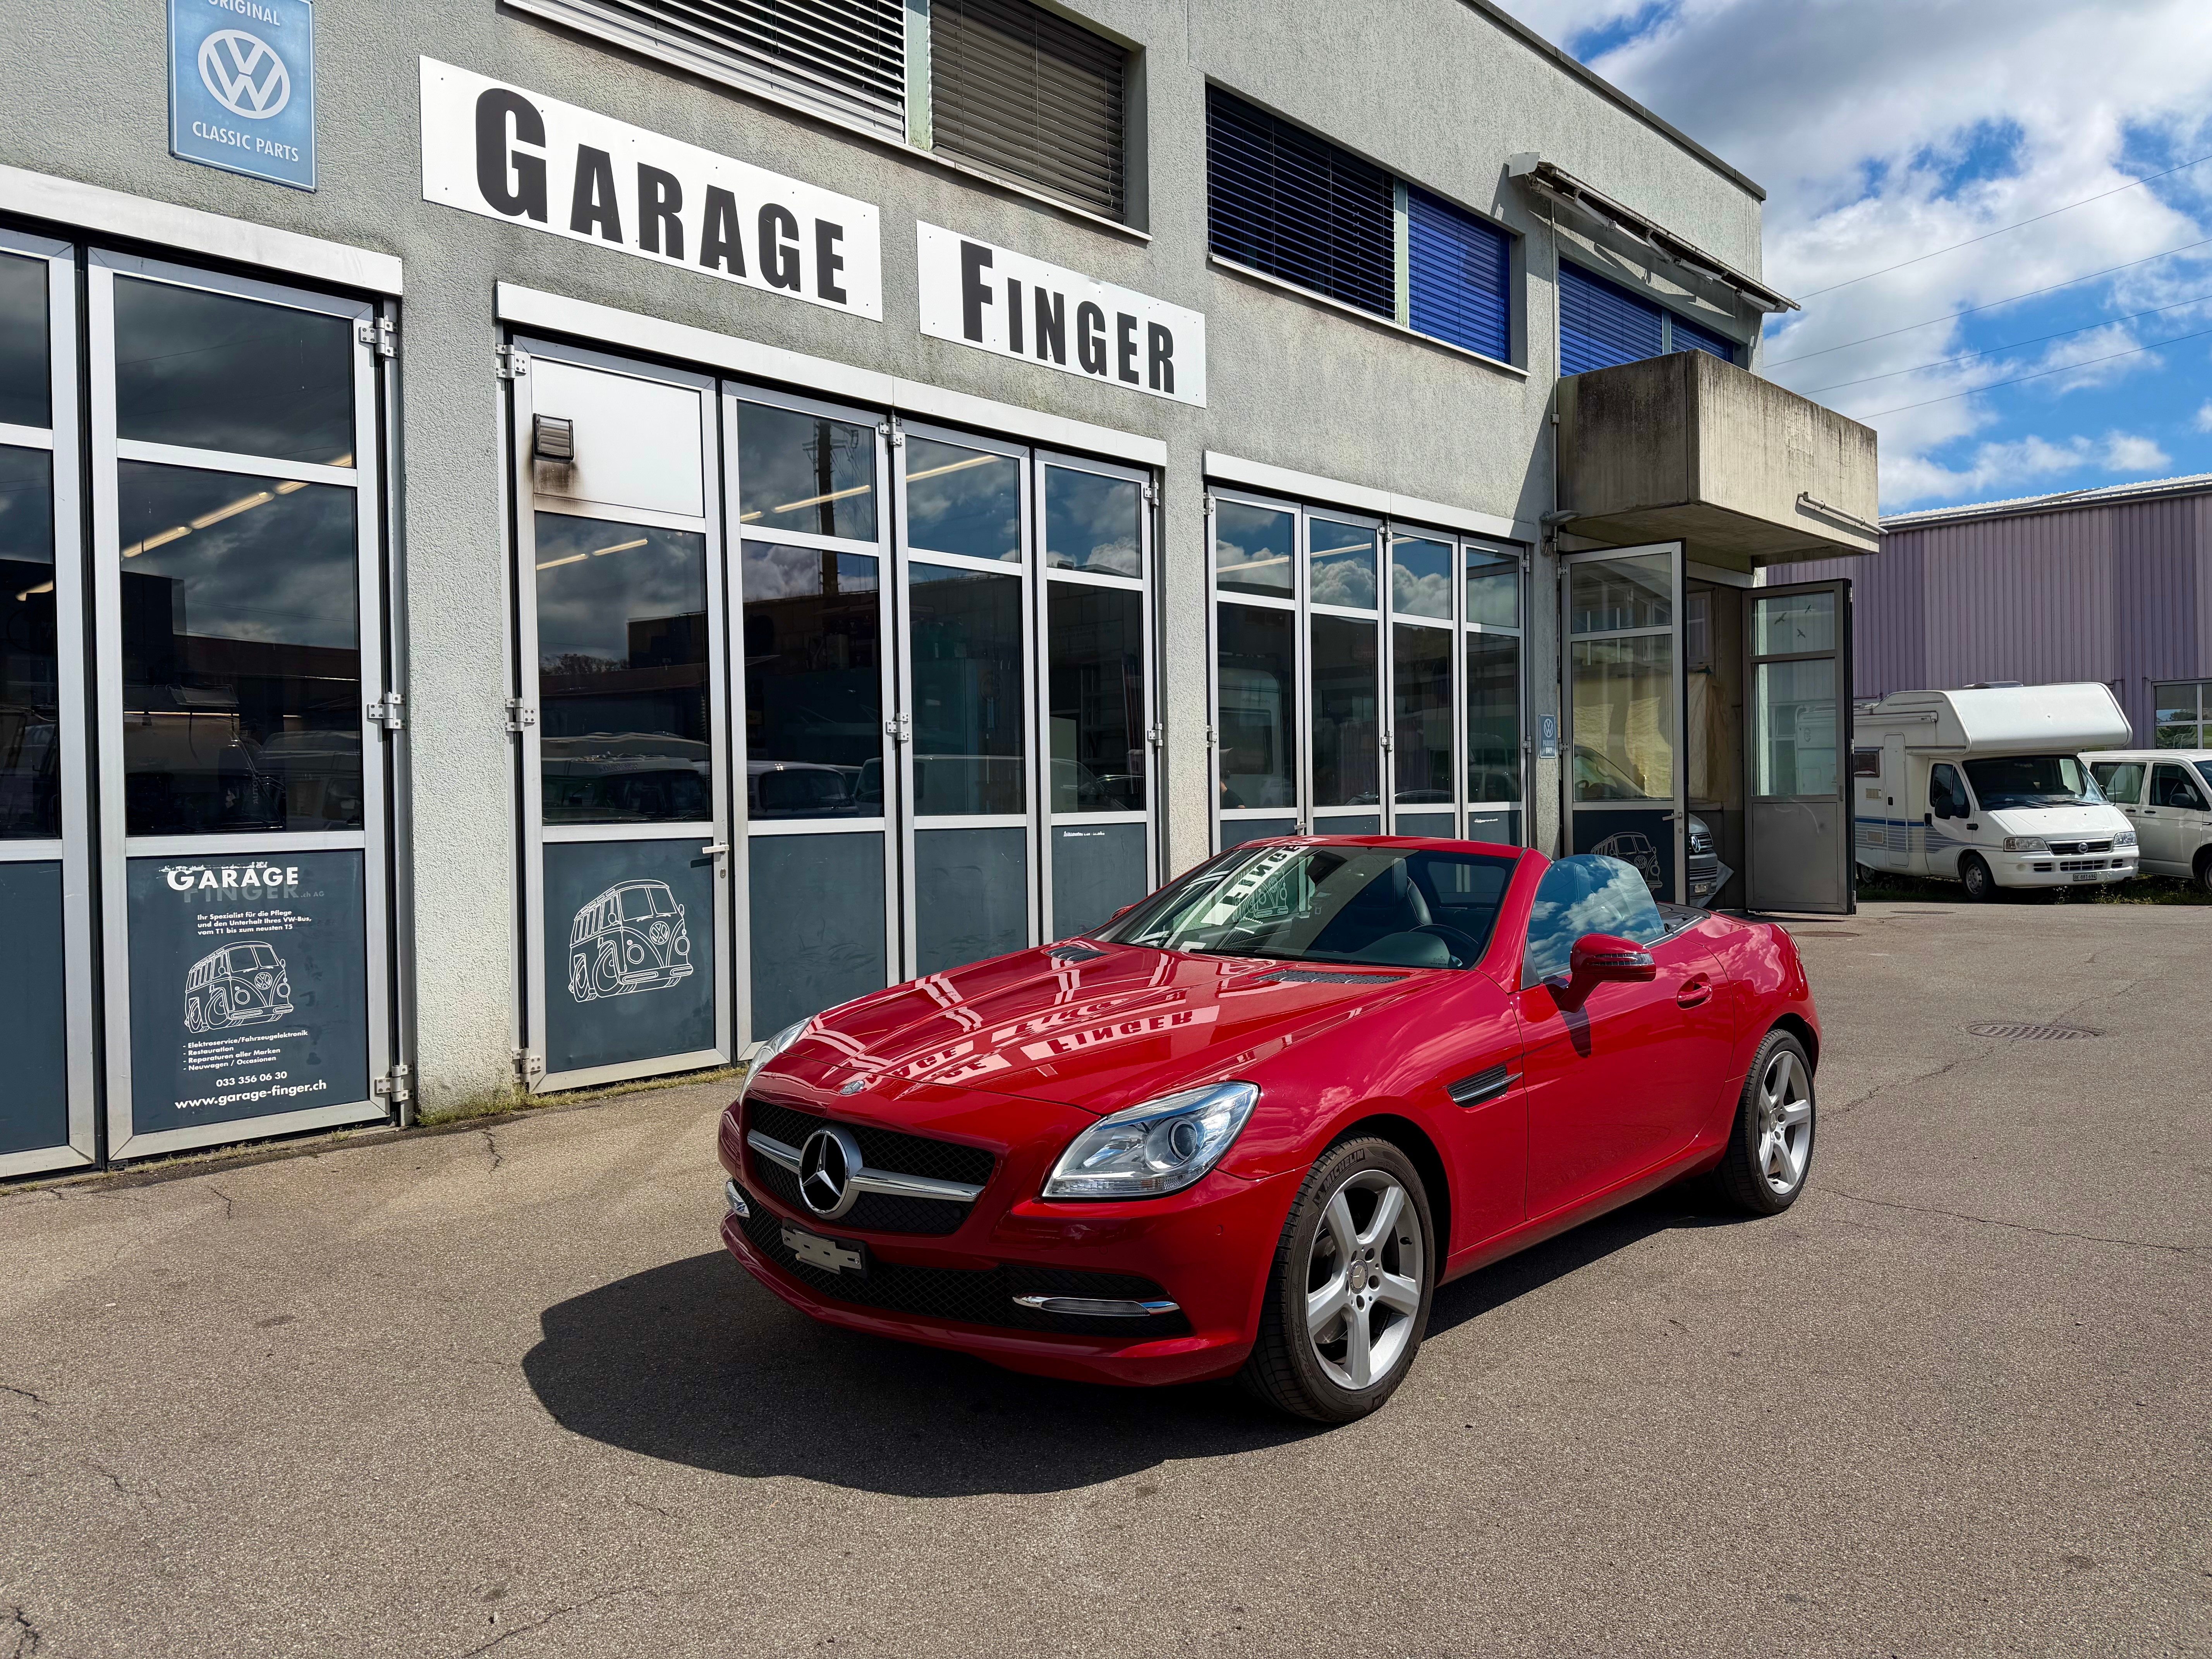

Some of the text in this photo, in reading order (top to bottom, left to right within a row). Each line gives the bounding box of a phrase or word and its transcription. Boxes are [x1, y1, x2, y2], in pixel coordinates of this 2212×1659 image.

[192, 121, 299, 162] CLASSIC PARTS
[476, 89, 1174, 394] GARAGE FINGER
[167, 867, 299, 891] GARAGE
[210, 912, 244, 921] Spezialist
[229, 918, 263, 926] Unterhalt
[188, 1030, 308, 1048] Elektroservice/Fahrzeugelektronik
[188, 1046, 234, 1056] Restauration
[188, 1054, 234, 1064] Reparaturen
[188, 1063, 228, 1071] Neuwagen
[236, 1056, 276, 1065] Occasionen
[216, 1071, 287, 1087] 033 356 06 30
[174, 1079, 327, 1109] www.garage-finger.ch
[1322, 1148, 1365, 1191] MICHELIN
